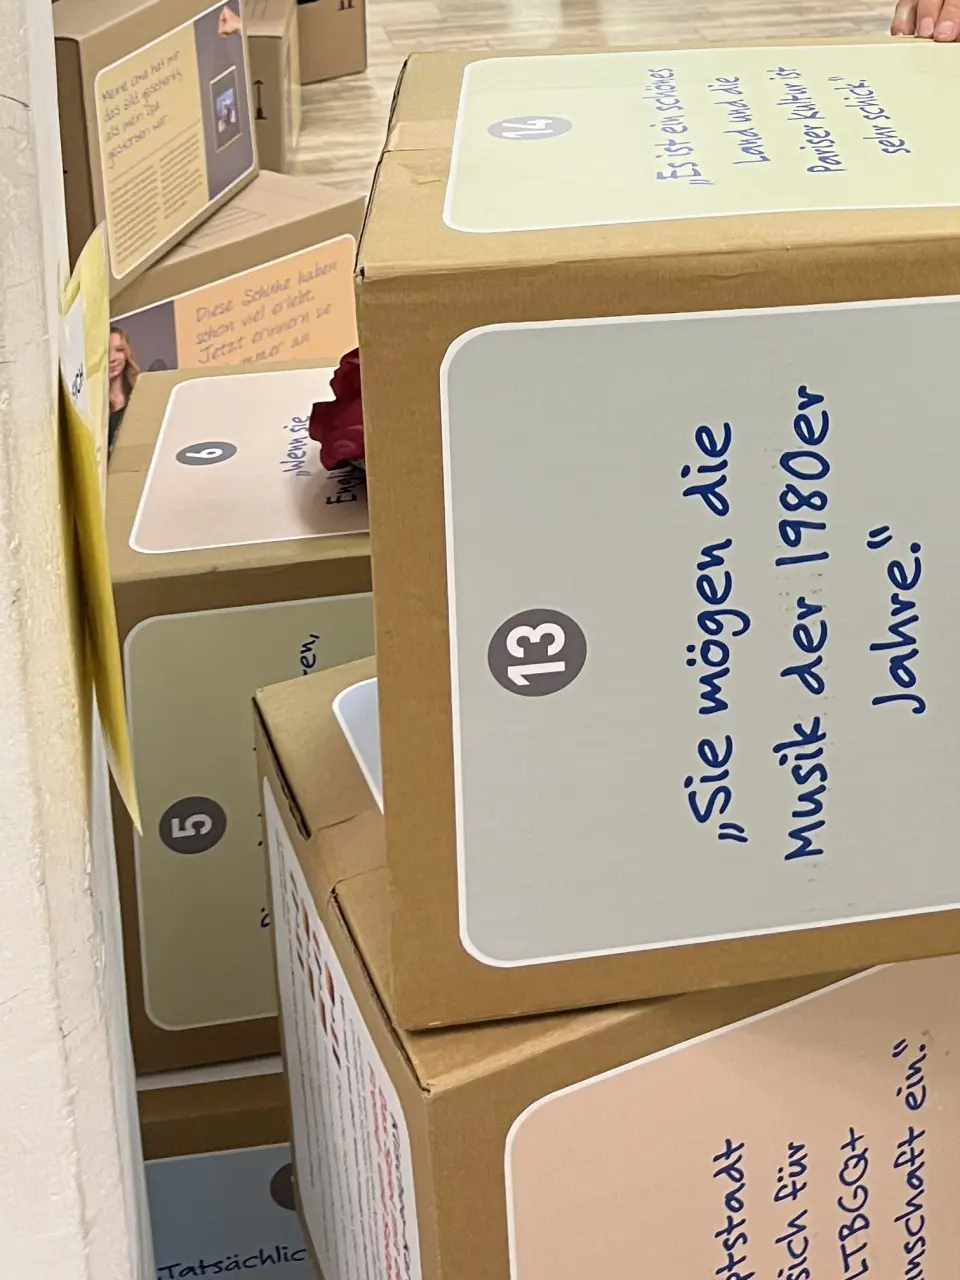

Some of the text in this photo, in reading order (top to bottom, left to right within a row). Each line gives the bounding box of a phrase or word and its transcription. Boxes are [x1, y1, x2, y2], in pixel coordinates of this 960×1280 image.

[642, 68, 683, 111] schönes
[502, 119, 553, 138] 14
[649, 115, 688, 134] ein
[708, 76, 771, 164] Land und die
[767, 66, 848, 173] Pariser Kultur ist
[654, 139, 694, 158] ist
[863, 125, 911, 155] sehr
[283, 415, 310, 432] sie
[186, 447, 223, 459] 6
[681, 422, 732, 516] die
[686, 538, 751, 715] mögen
[772, 385, 830, 861] Musik der 1980er
[507, 622, 566, 686] 13
[171, 813, 212, 838] 5
[774, 1142, 810, 1280] sich für
[157, 1245, 308, 1280] Tatsächlic
